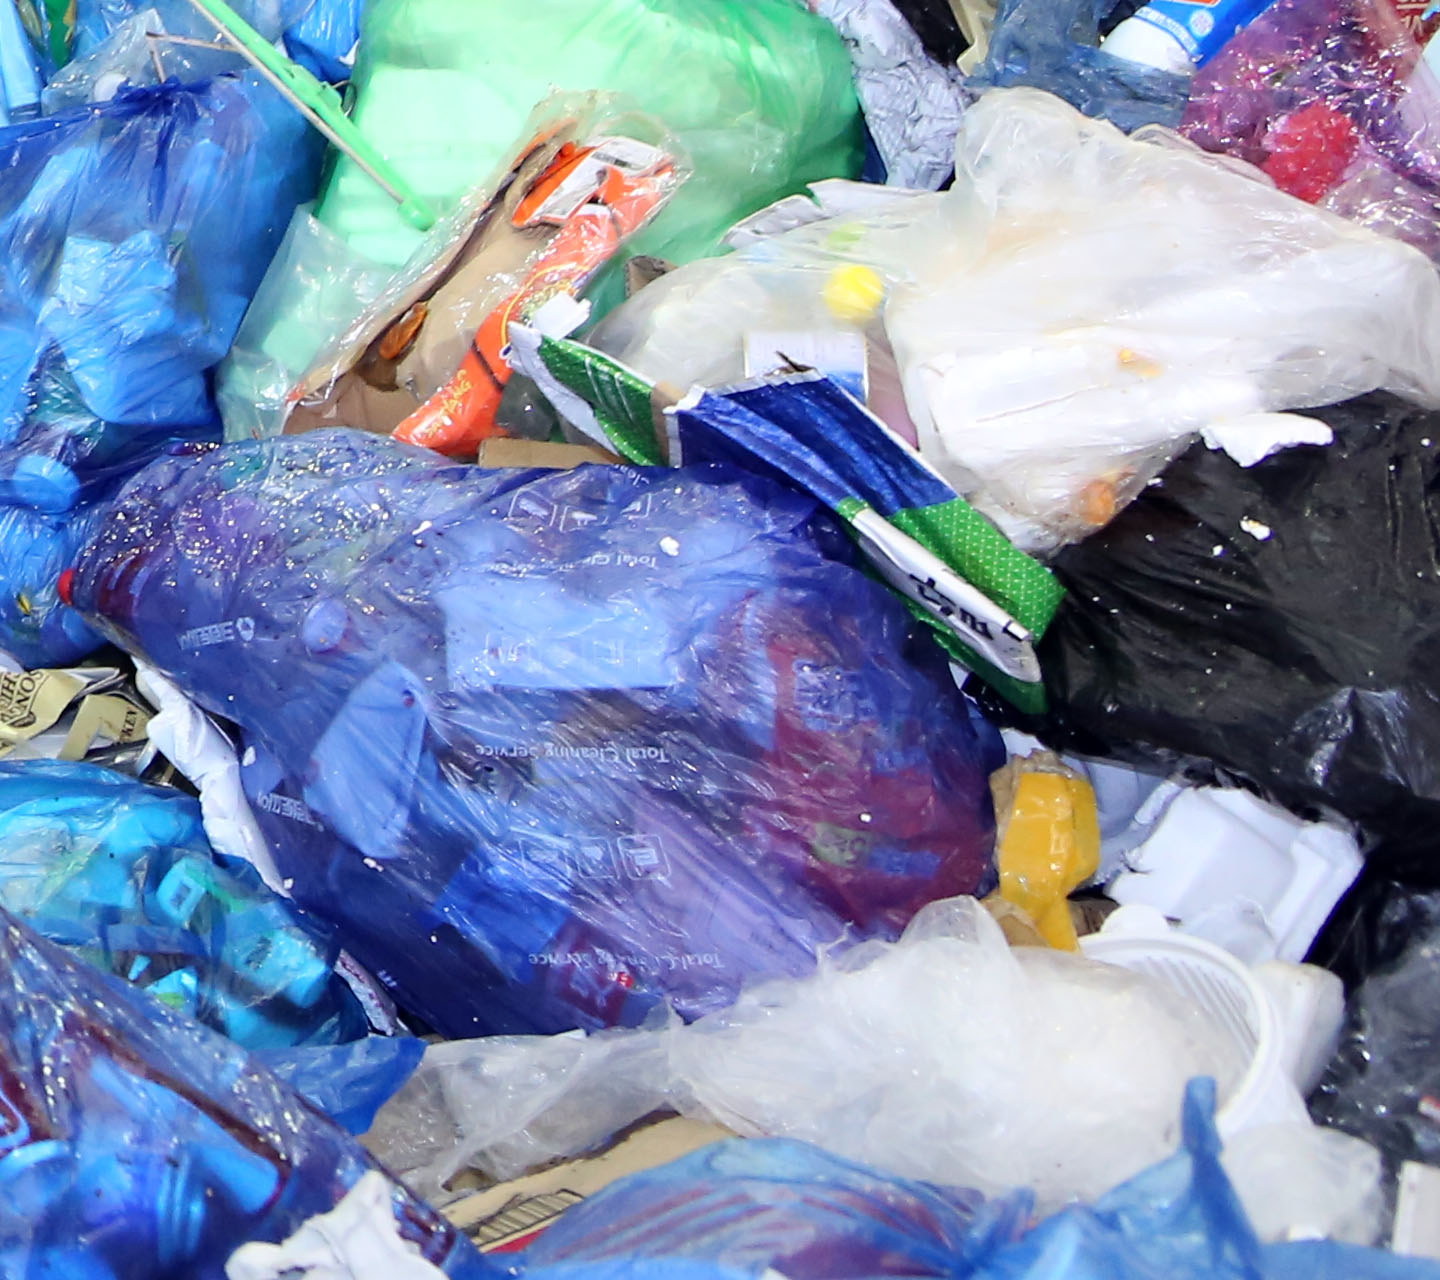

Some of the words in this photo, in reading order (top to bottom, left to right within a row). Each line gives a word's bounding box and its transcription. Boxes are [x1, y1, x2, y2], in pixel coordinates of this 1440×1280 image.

[474, 742, 540, 761] Service
[542, 742, 621, 764] Cleaning
[624, 744, 669, 764] Total
[527, 951, 596, 970] Service
